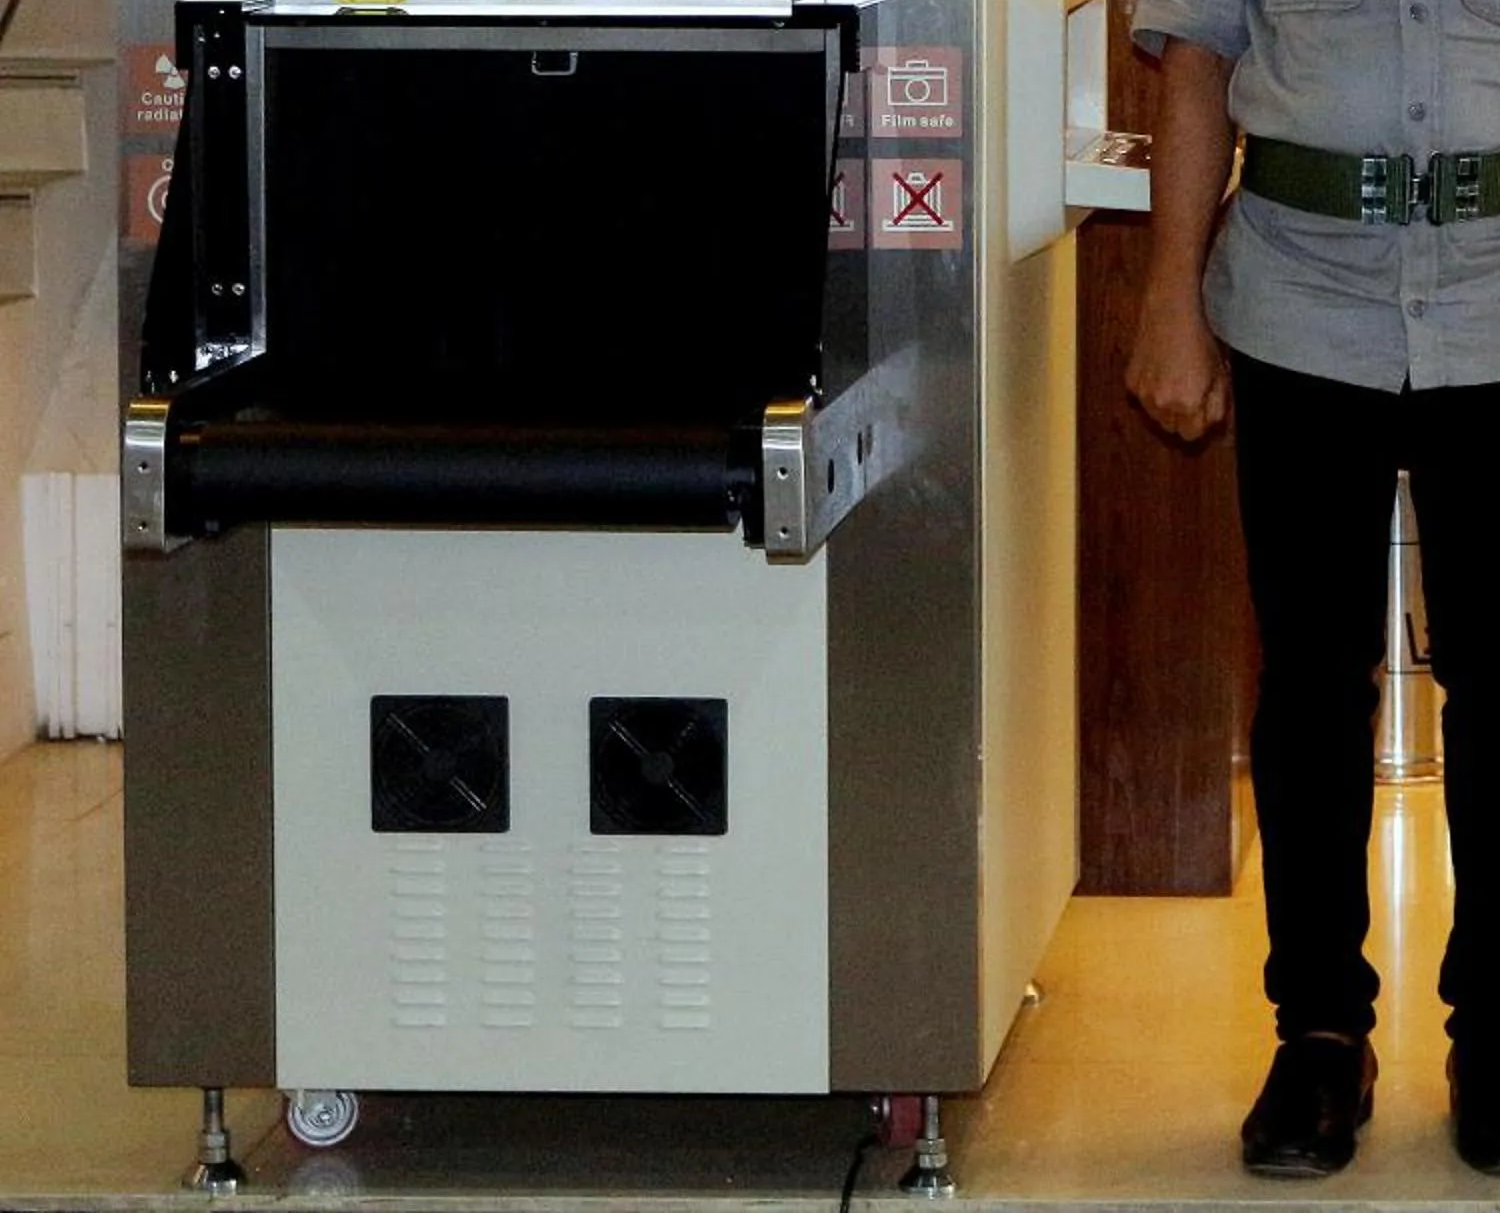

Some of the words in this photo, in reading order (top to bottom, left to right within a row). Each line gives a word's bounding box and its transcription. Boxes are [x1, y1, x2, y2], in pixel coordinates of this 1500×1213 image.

[141, 92, 185, 106] Cauti
[881, 114, 917, 128] Film
[919, 114, 954, 127] safe
